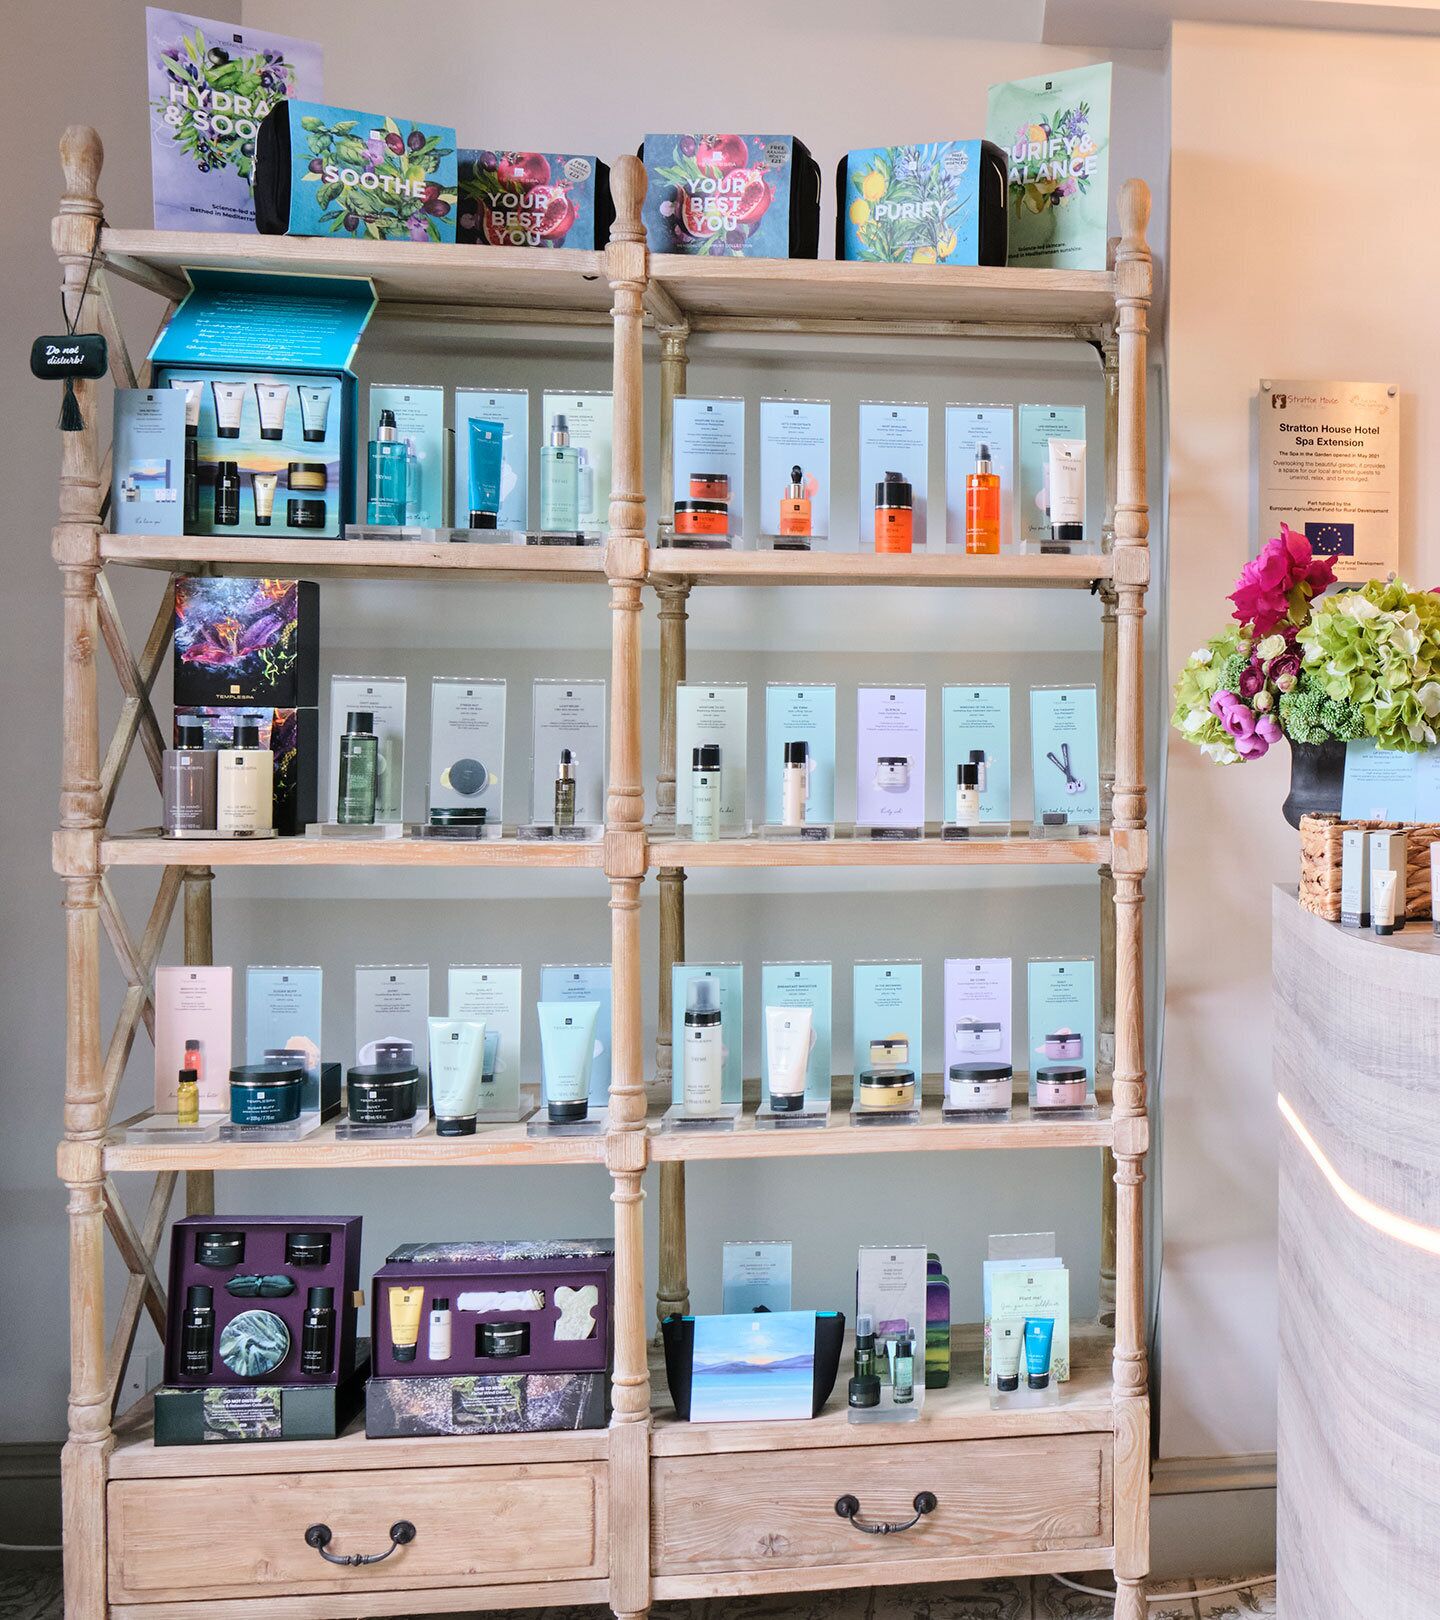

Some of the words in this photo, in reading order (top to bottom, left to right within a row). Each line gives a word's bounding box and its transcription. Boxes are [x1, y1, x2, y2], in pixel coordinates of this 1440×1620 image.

[169, 83, 271, 118] HYDRA
[164, 105, 183, 126] &
[193, 110, 257, 139] SOO
[1079, 134, 1094, 154] &
[1008, 155, 1099, 185] ALANCE
[324, 165, 427, 199] SOOTHE
[686, 178, 745, 194] YOUR
[487, 193, 548, 209] YOUR
[691, 197, 742, 212] BEST
[190, 207, 213, 215] Bathed
[223, 212, 256, 222] Mediterran
[212, 203, 250, 215] Science-led
[874, 201, 948, 221] PURIFY
[491, 211, 545, 227] BEST
[693, 216, 738, 231] YOU
[496, 230, 541, 246] YOU
[46, 345, 61, 356] Do
[62, 345, 80, 355] not
[47, 354, 85, 365] disturb!
[1287, 394, 1317, 405] Stratton
[1320, 396, 1340, 405] House
[1279, 423, 1319, 433] Stratton
[1321, 424, 1352, 434] House
[1355, 426, 1380, 435] Hotel
[1295, 436, 1314, 447] Spa
[1317, 437, 1364, 447] Extension
[1273, 459, 1304, 468] Overlooking
